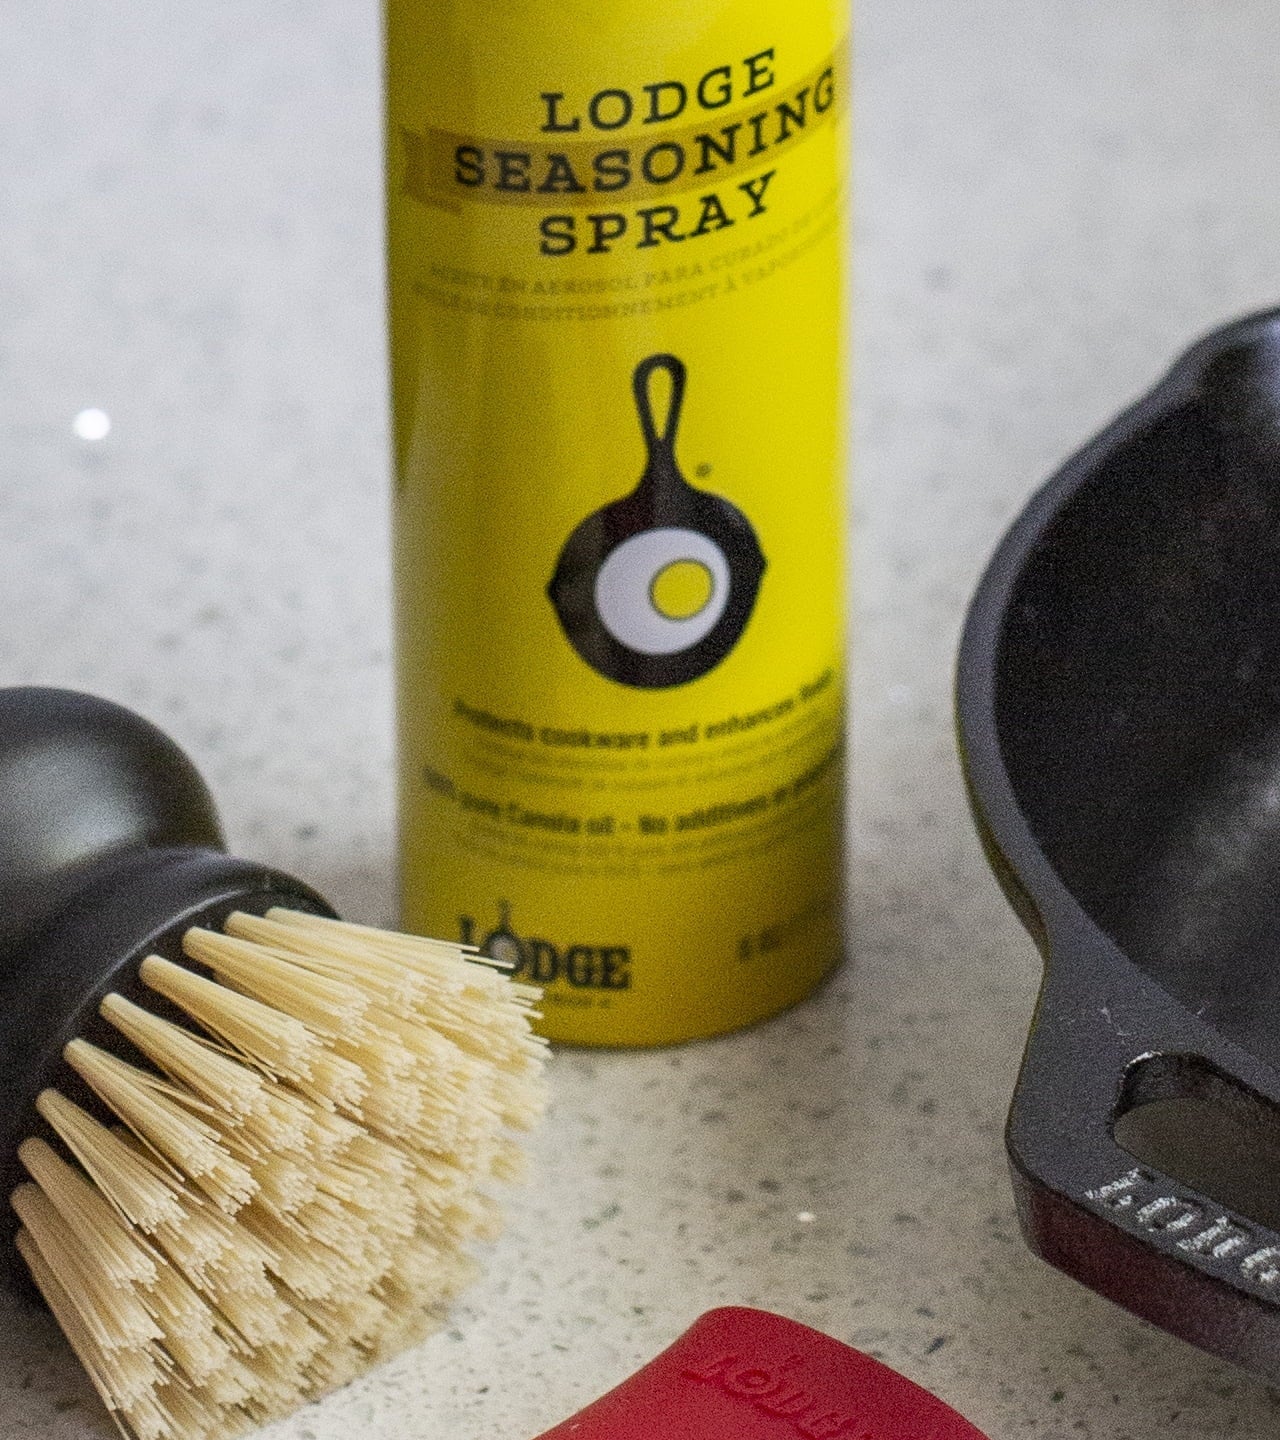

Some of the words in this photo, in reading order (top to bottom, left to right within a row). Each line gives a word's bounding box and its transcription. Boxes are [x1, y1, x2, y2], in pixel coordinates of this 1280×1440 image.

[454, 67, 835, 196] SEASONING
[540, 47, 776, 134] LODGE
[539, 169, 777, 258] SPRAY
[539, 726, 649, 749] cookware
[658, 722, 698, 748] and
